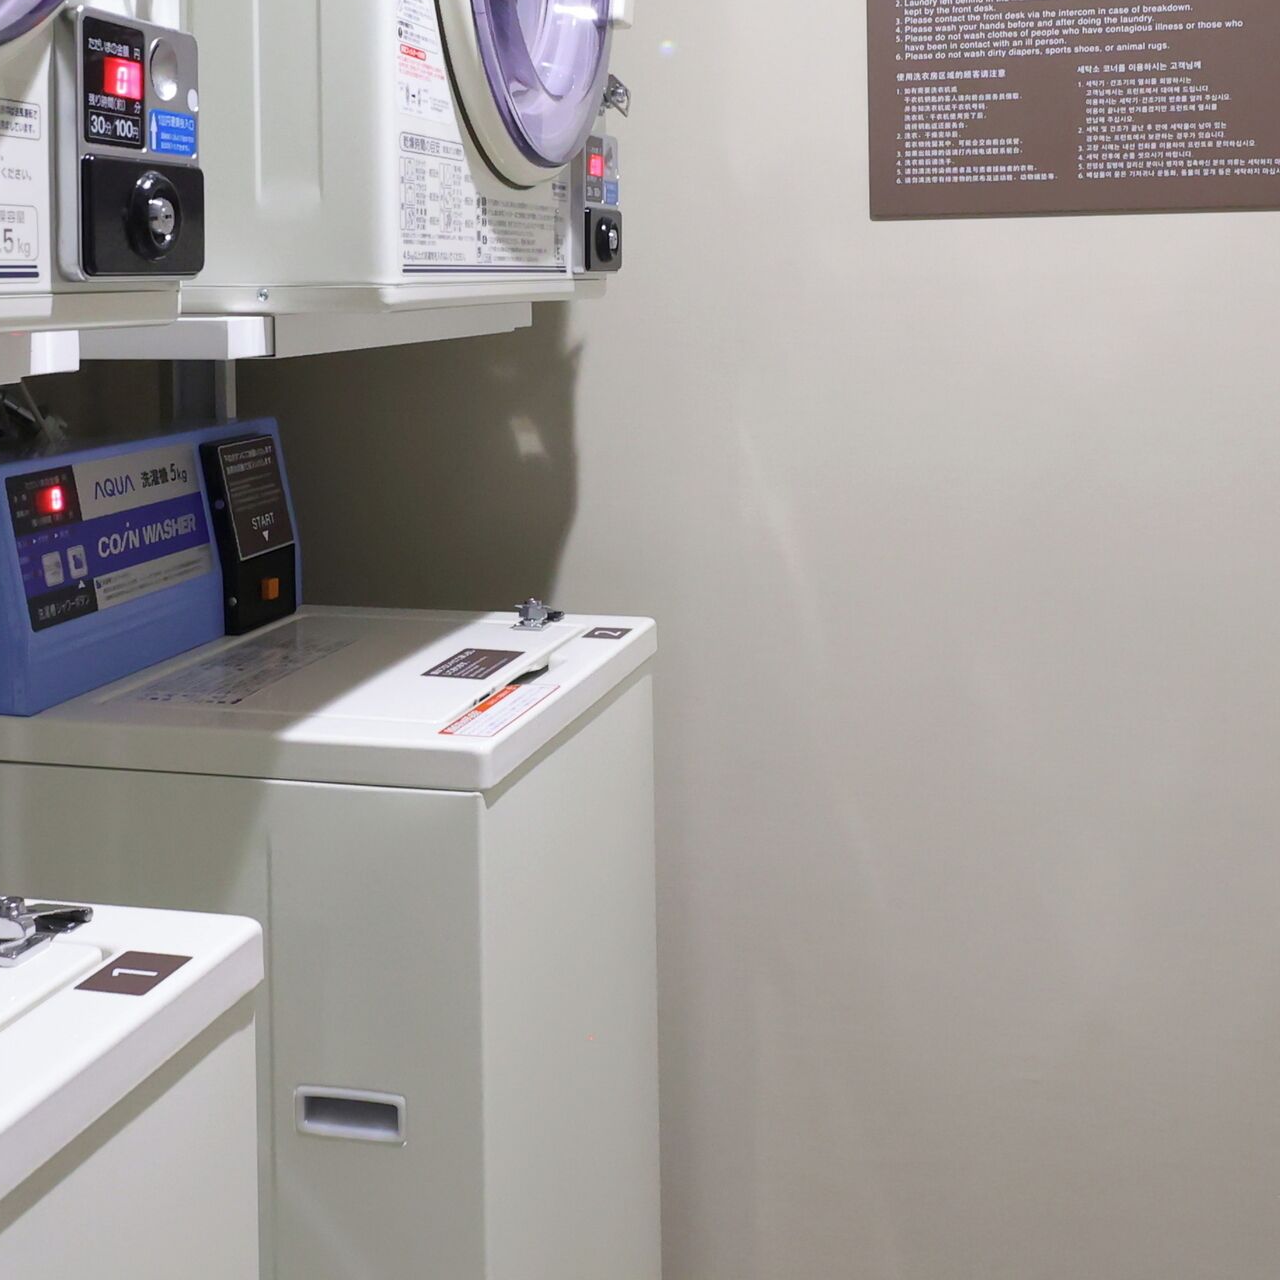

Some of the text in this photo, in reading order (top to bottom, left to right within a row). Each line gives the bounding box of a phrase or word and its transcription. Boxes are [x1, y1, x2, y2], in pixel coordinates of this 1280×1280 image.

[904, 15, 932, 24] Please
[983, 12, 1002, 20] front
[1005, 11, 1024, 19] desk
[1027, 10, 1039, 18] via
[1042, 9, 1055, 17] the
[1058, 7, 1095, 16] intercom
[1131, 5, 1139, 13] of
[905, 51, 932, 60] Please
[935, 51, 945, 59] do
[963, 49, 985, 57] wash
[987, 49, 1006, 58] dirty
[1045, 46, 1071, 55] sports
[1116, 42, 1145, 50] animal
[116, 67, 128, 94] 0
[94, 475, 135, 500] AQUA
[170, 463, 188, 483] 5kg
[252, 513, 274, 530] START
[98, 513, 196, 559] COIN WASHER
[112, 966, 158, 978] 1
